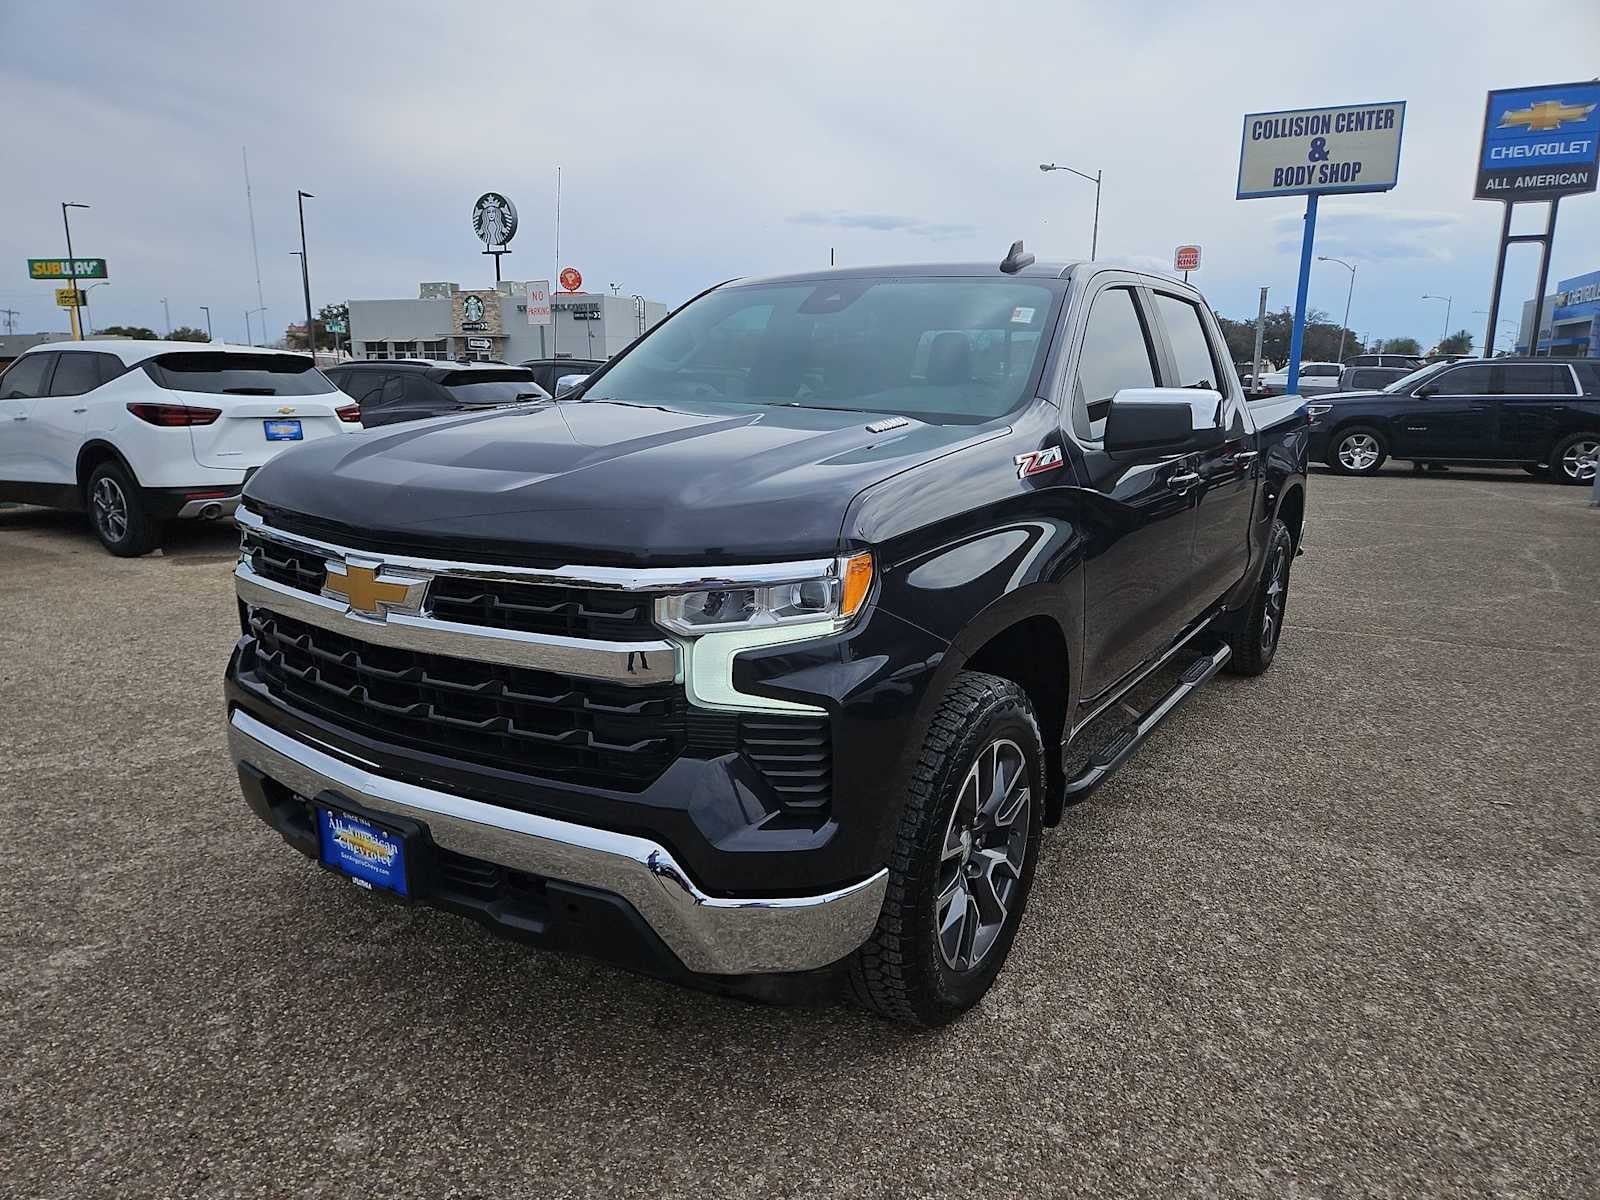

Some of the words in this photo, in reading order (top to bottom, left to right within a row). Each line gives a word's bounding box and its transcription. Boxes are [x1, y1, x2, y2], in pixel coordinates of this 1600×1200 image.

[1252, 114, 1332, 141] COLLISION
[1335, 109, 1395, 134] CENTER
[1308, 137, 1330, 162] &
[1491, 140, 1591, 160] CHEVROLET
[1273, 165, 1316, 187] BODY
[1319, 162, 1362, 184] SHOP
[1485, 178, 1510, 190] ALL
[1514, 172, 1588, 188] AMERICAN
[32, 262, 97, 275] SUBWAY
[531, 290, 544, 301] NO
[527, 307, 550, 317] PARKING
